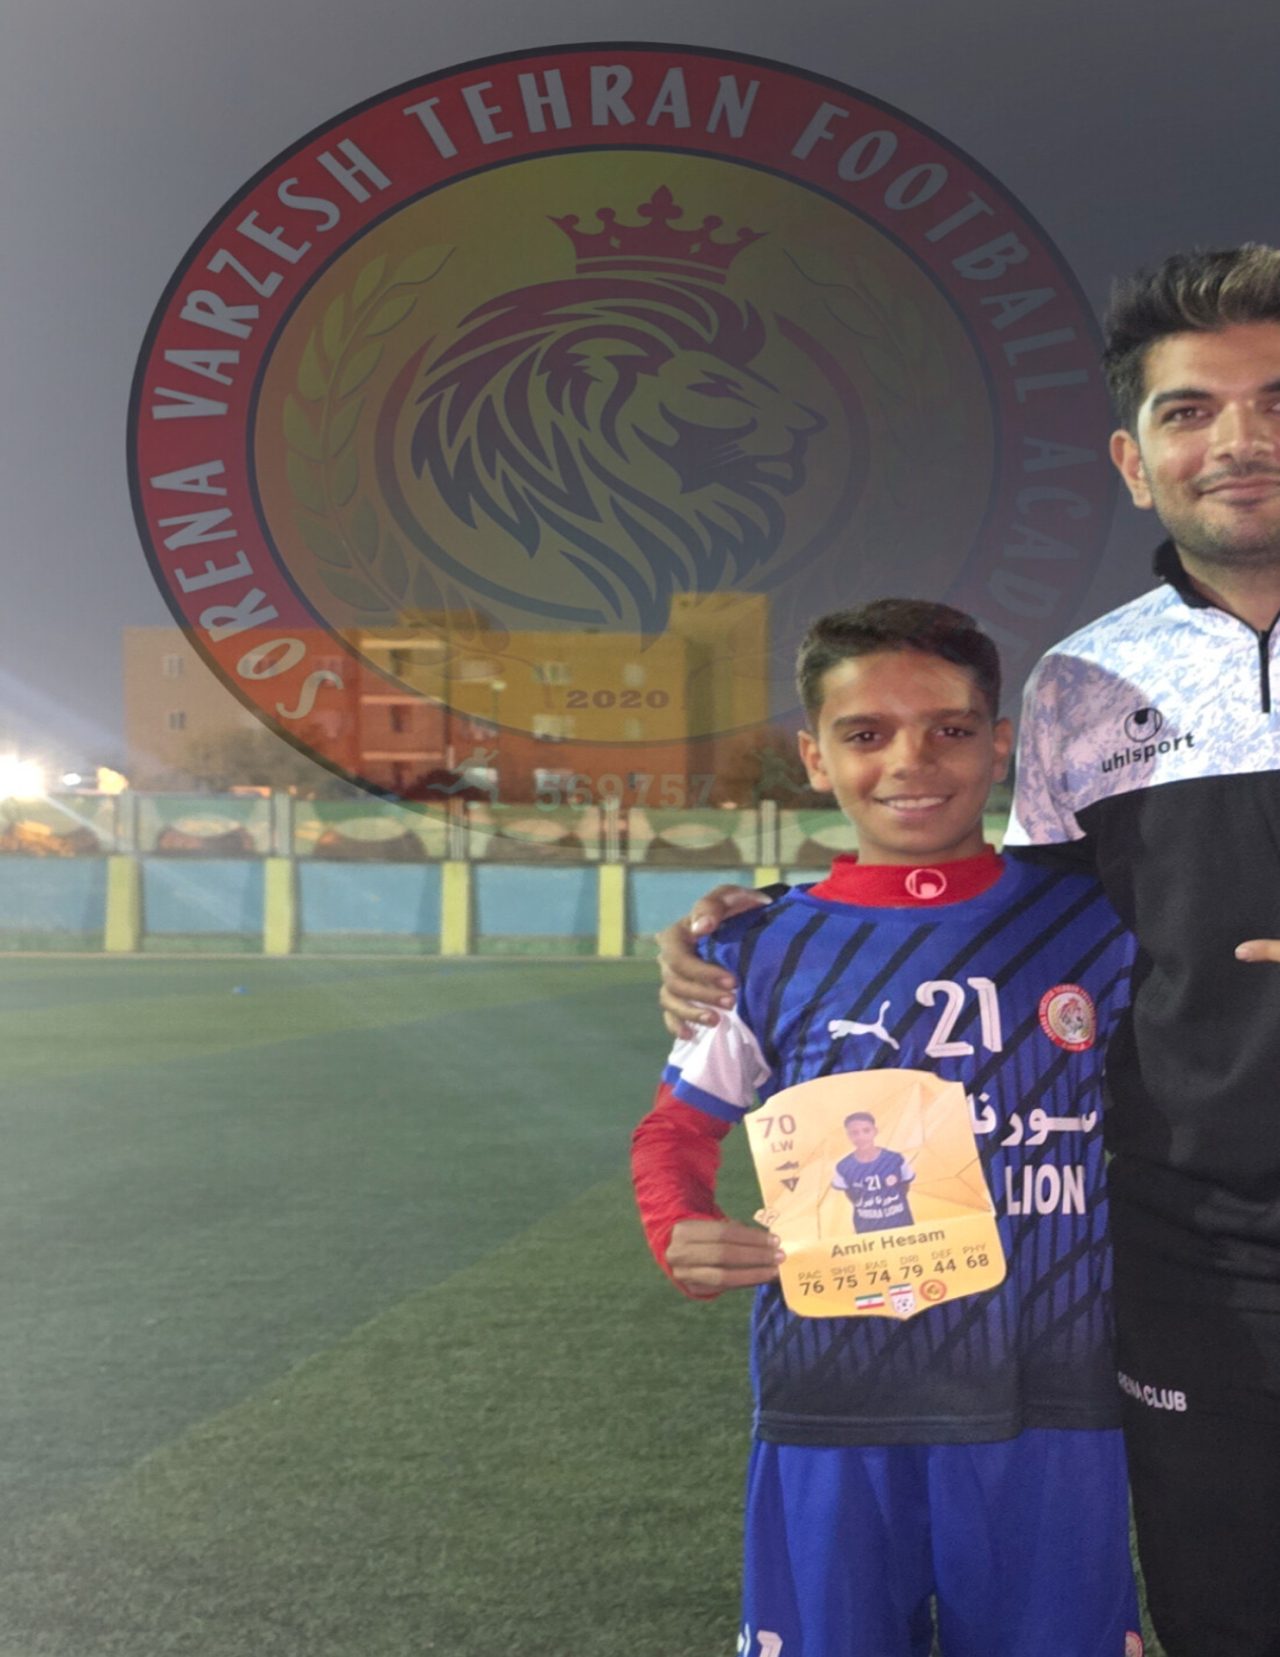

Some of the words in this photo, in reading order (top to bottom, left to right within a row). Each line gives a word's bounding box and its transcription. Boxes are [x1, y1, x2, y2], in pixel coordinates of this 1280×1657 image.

[1101, 732, 1195, 774] uhlsport
[915, 977, 1003, 1058] 21
[757, 1114, 796, 1139] 70
[771, 1140, 794, 1153] LW
[865, 1174, 881, 1191] 21
[1005, 1164, 1086, 1216] LION
[831, 1239, 875, 1258] Amir
[881, 1229, 945, 1250] Hesam
[800, 1280, 825, 1296] 76
[833, 1275, 858, 1291] 75
[867, 1270, 891, 1285] 74
[900, 1264, 923, 1279] 79
[933, 1259, 956, 1274] 44
[966, 1253, 989, 1269] 68
[1143, 1385, 1187, 1412] CLUB
